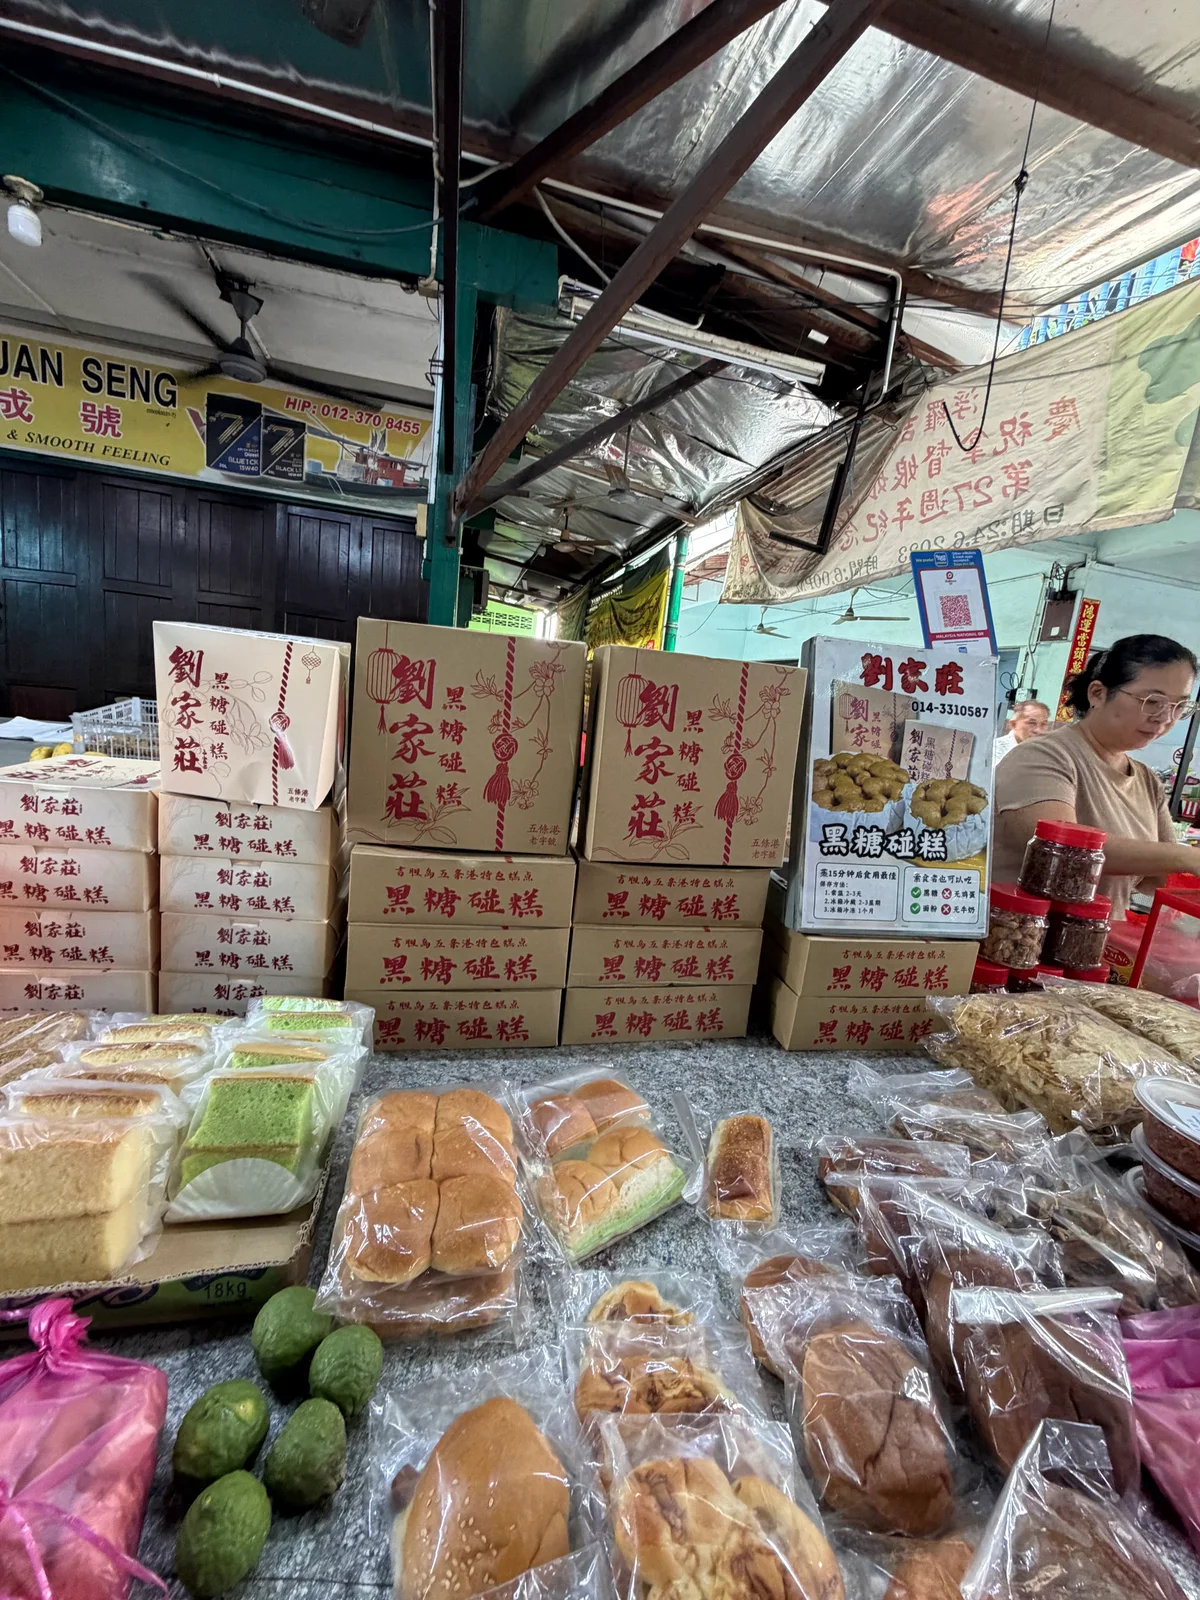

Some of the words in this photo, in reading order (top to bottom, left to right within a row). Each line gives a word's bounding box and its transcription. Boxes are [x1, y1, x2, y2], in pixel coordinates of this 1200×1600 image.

[82, 357, 178, 408] SENG
[321, 404, 382, 427] 012-370
[385, 417, 421, 435] 8455
[7, 429, 19, 441] &
[25, 431, 95, 453] SMOOTH
[101, 445, 170, 467] FEELING
[860, 652, 964, 696] 劉家莊
[168, 645, 204, 774] 劉家莊
[209, 672, 230, 760] 黑糖碰糕
[911, 701, 989, 718] 014-3310587
[380, 654, 437, 821] 劉家莊
[435, 686, 468, 807] 黑糖碰糕
[623, 680, 679, 840] 劉家莊
[673, 709, 704, 824] 黑糖碰糕
[20, 793, 80, 816] 劉家莊
[0, 820, 111, 845] 黑糖碰糕
[215, 811, 270, 831] 劉家莊
[193, 833, 298, 857] 黑糖碰糕
[820, 824, 947, 861] 黑糖碰糕
[19, 856, 78, 876] 劉家莊
[216, 868, 269, 888] 劉家莊
[0, 881, 109, 904] 黑糖碰糕
[194, 891, 295, 913] 黑糖碰糕
[382, 884, 543, 918] 黑糖碰糕
[602, 890, 740, 921] 黑糖碰糕
[24, 921, 83, 938] 劉家莊
[217, 927, 268, 946] 劉家莊
[3, 944, 115, 964] 黑糖碰糕
[194, 950, 294, 971] 黑糖碰糕
[598, 954, 734, 982] 黑糖碰糕
[380, 953, 538, 985] 黑糖碰糕
[826, 964, 949, 992] 黑糖碰糕
[24, 983, 82, 1000] 劉家莊
[213, 983, 265, 1001] 劉家莊
[374, 1015, 529, 1046] 黑糖碰糕
[591, 1006, 724, 1038] 黑糖碰糕
[203, 1281, 247, 1300] 18kg
